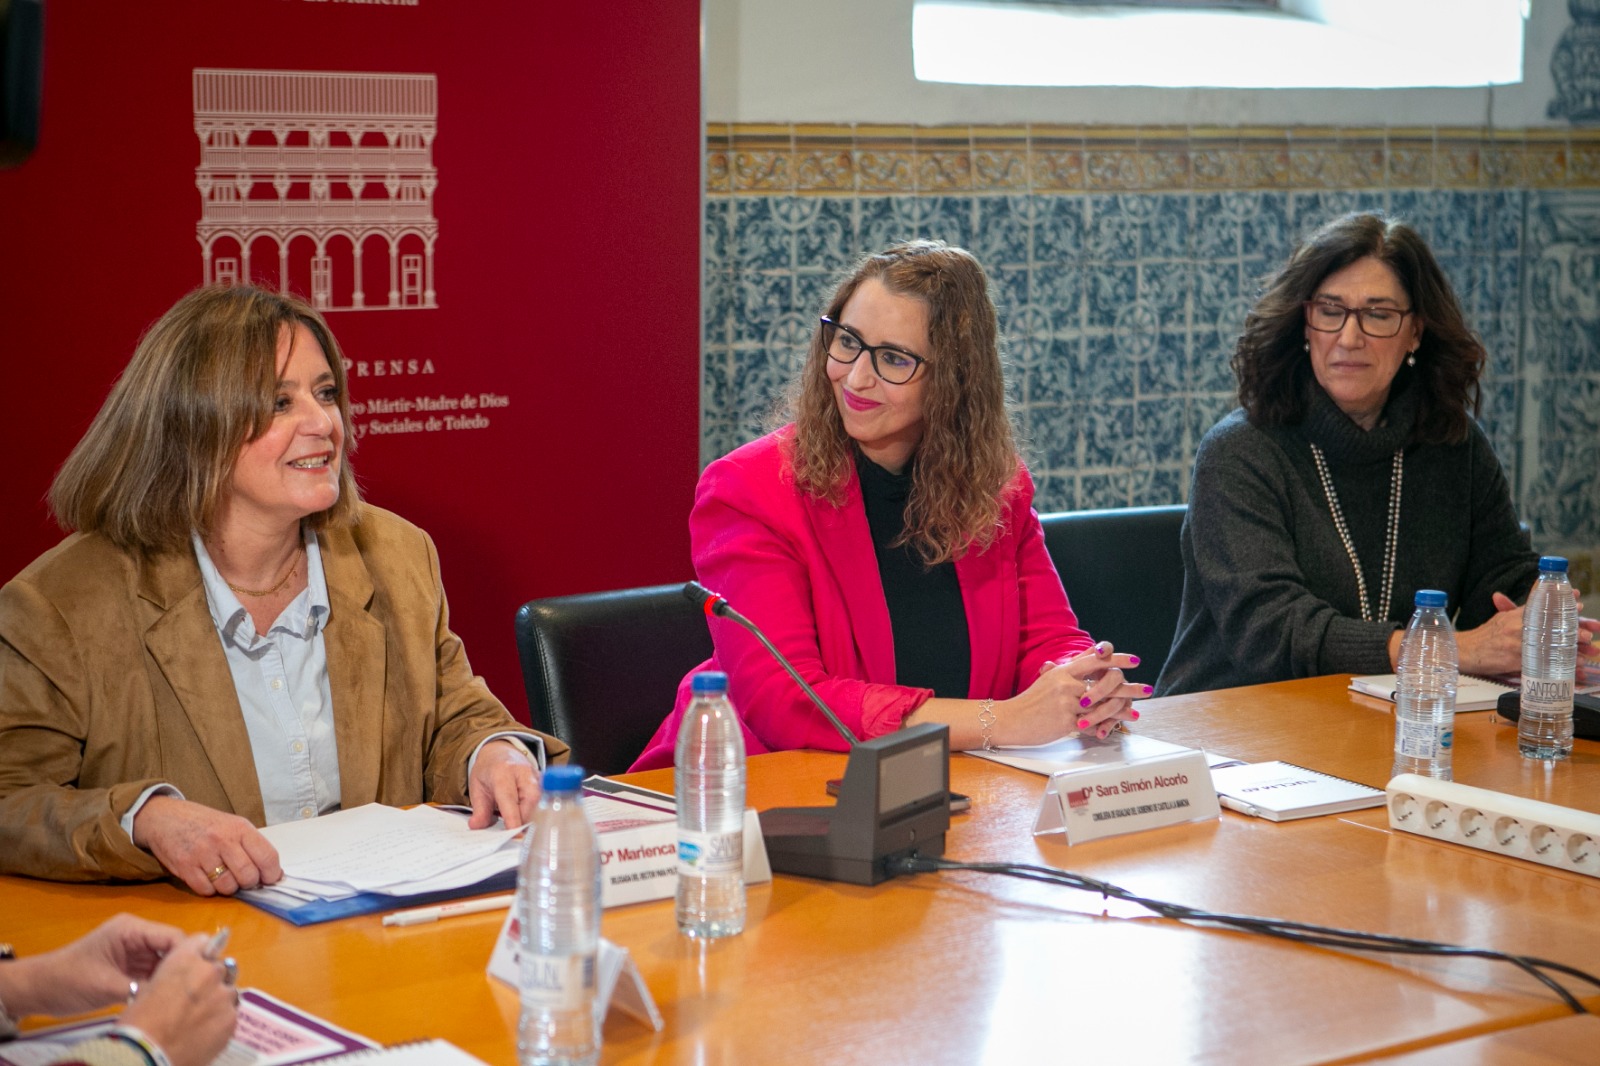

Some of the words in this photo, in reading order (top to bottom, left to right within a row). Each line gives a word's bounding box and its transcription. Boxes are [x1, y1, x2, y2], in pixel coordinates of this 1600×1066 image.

[341, 358, 435, 377] PRENSA
[367, 394, 459, 414] Mártir-Madre
[460, 394, 477, 409] de
[479, 392, 509, 408] Dios
[358, 423, 368, 438] y
[369, 417, 423, 435] Sociales
[425, 416, 442, 431] de
[443, 414, 490, 430] Toledo
[1096, 784, 1119, 797] Sara
[1120, 778, 1152, 794] Simón
[1154, 773, 1188, 788] Alcorlo
